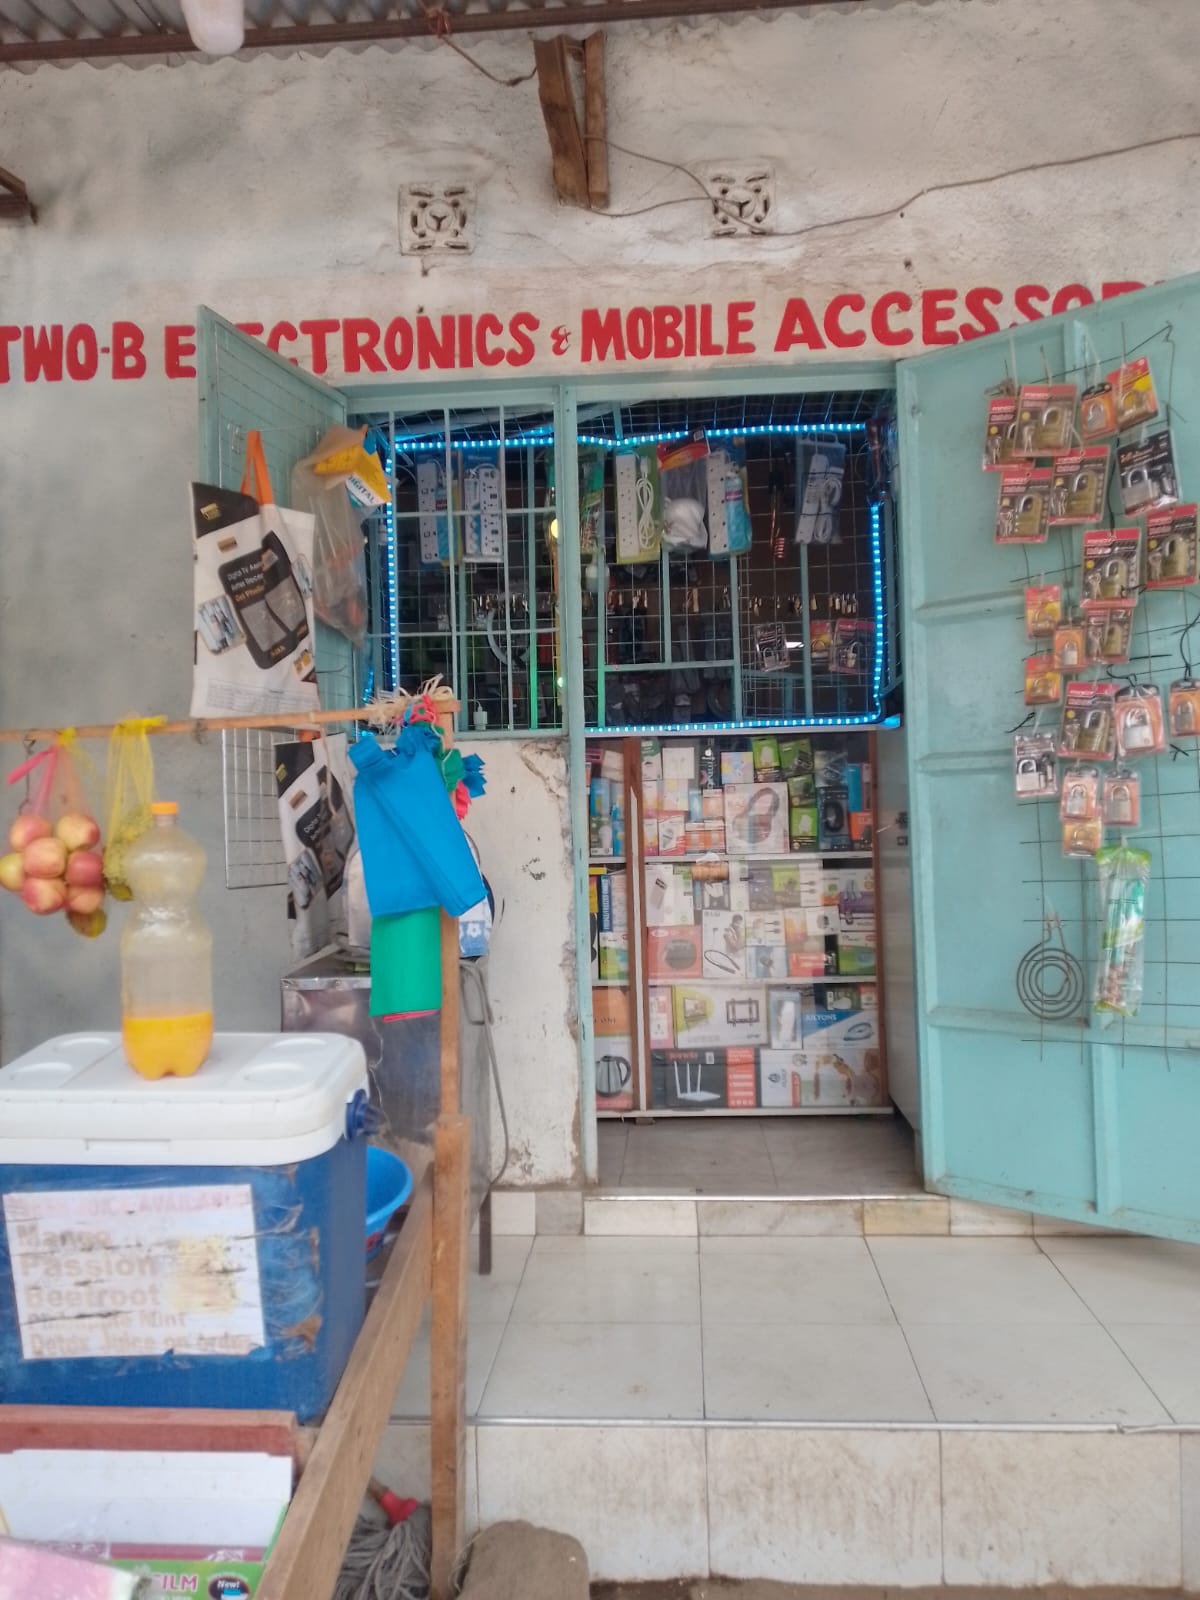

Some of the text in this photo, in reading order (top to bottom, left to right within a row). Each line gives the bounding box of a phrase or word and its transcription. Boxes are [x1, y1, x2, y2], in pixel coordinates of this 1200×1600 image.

[0, 280, 1166, 385] TWO-B ECTRONICS & MOBILE ACCESS
[20, 1254, 159, 1278] Passion
[24, 1284, 162, 1309] Beetroot
[155, 1574, 198, 1591] ILM
[216, 1579, 241, 1589] New!
